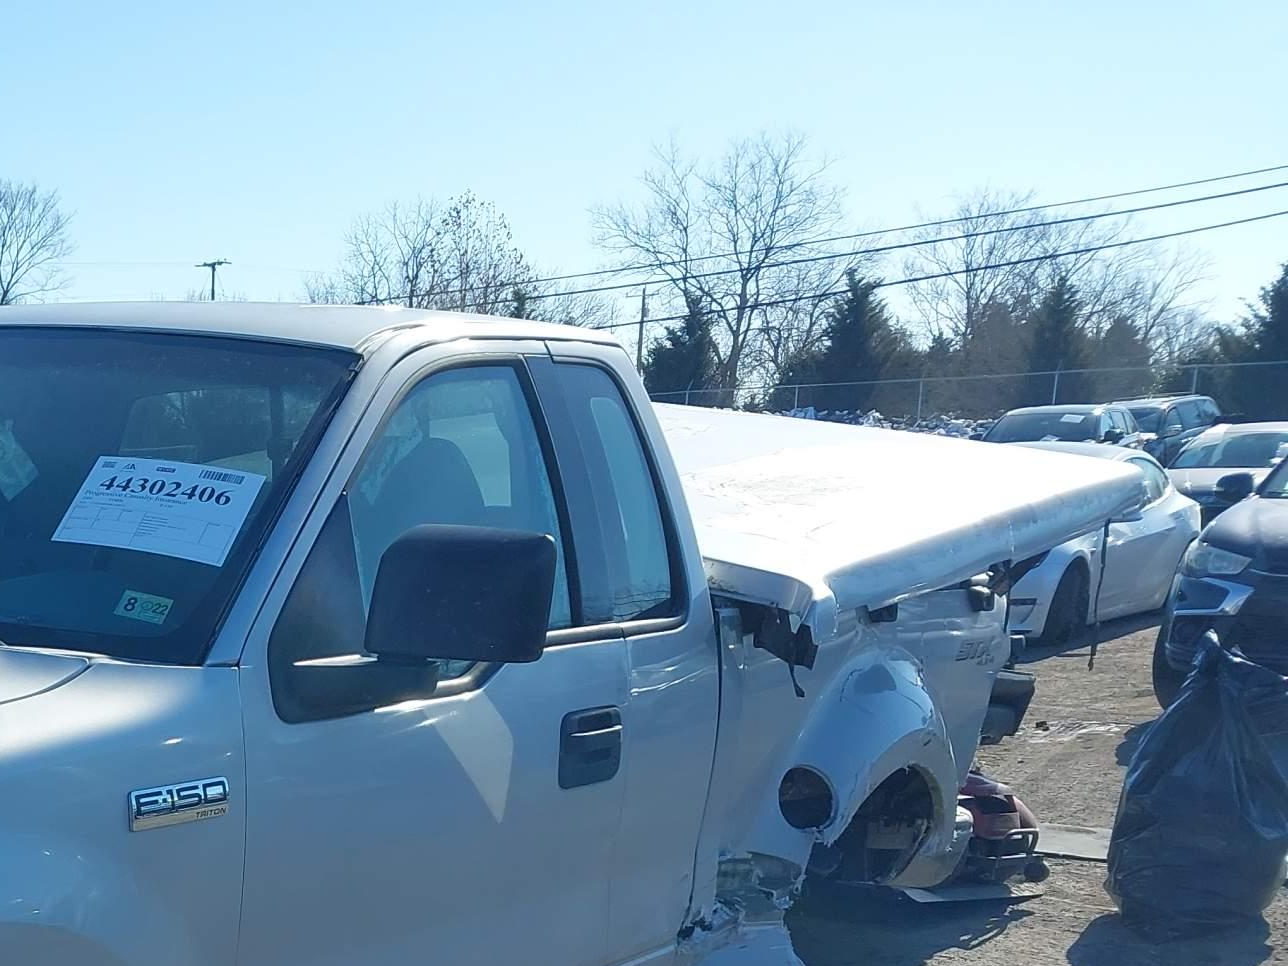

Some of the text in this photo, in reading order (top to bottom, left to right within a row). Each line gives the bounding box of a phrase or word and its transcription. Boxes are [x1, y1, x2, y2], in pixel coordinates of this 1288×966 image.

[99, 475, 235, 506] 44302406
[124, 597, 138, 611] 8
[195, 806, 227, 819] TRITON
